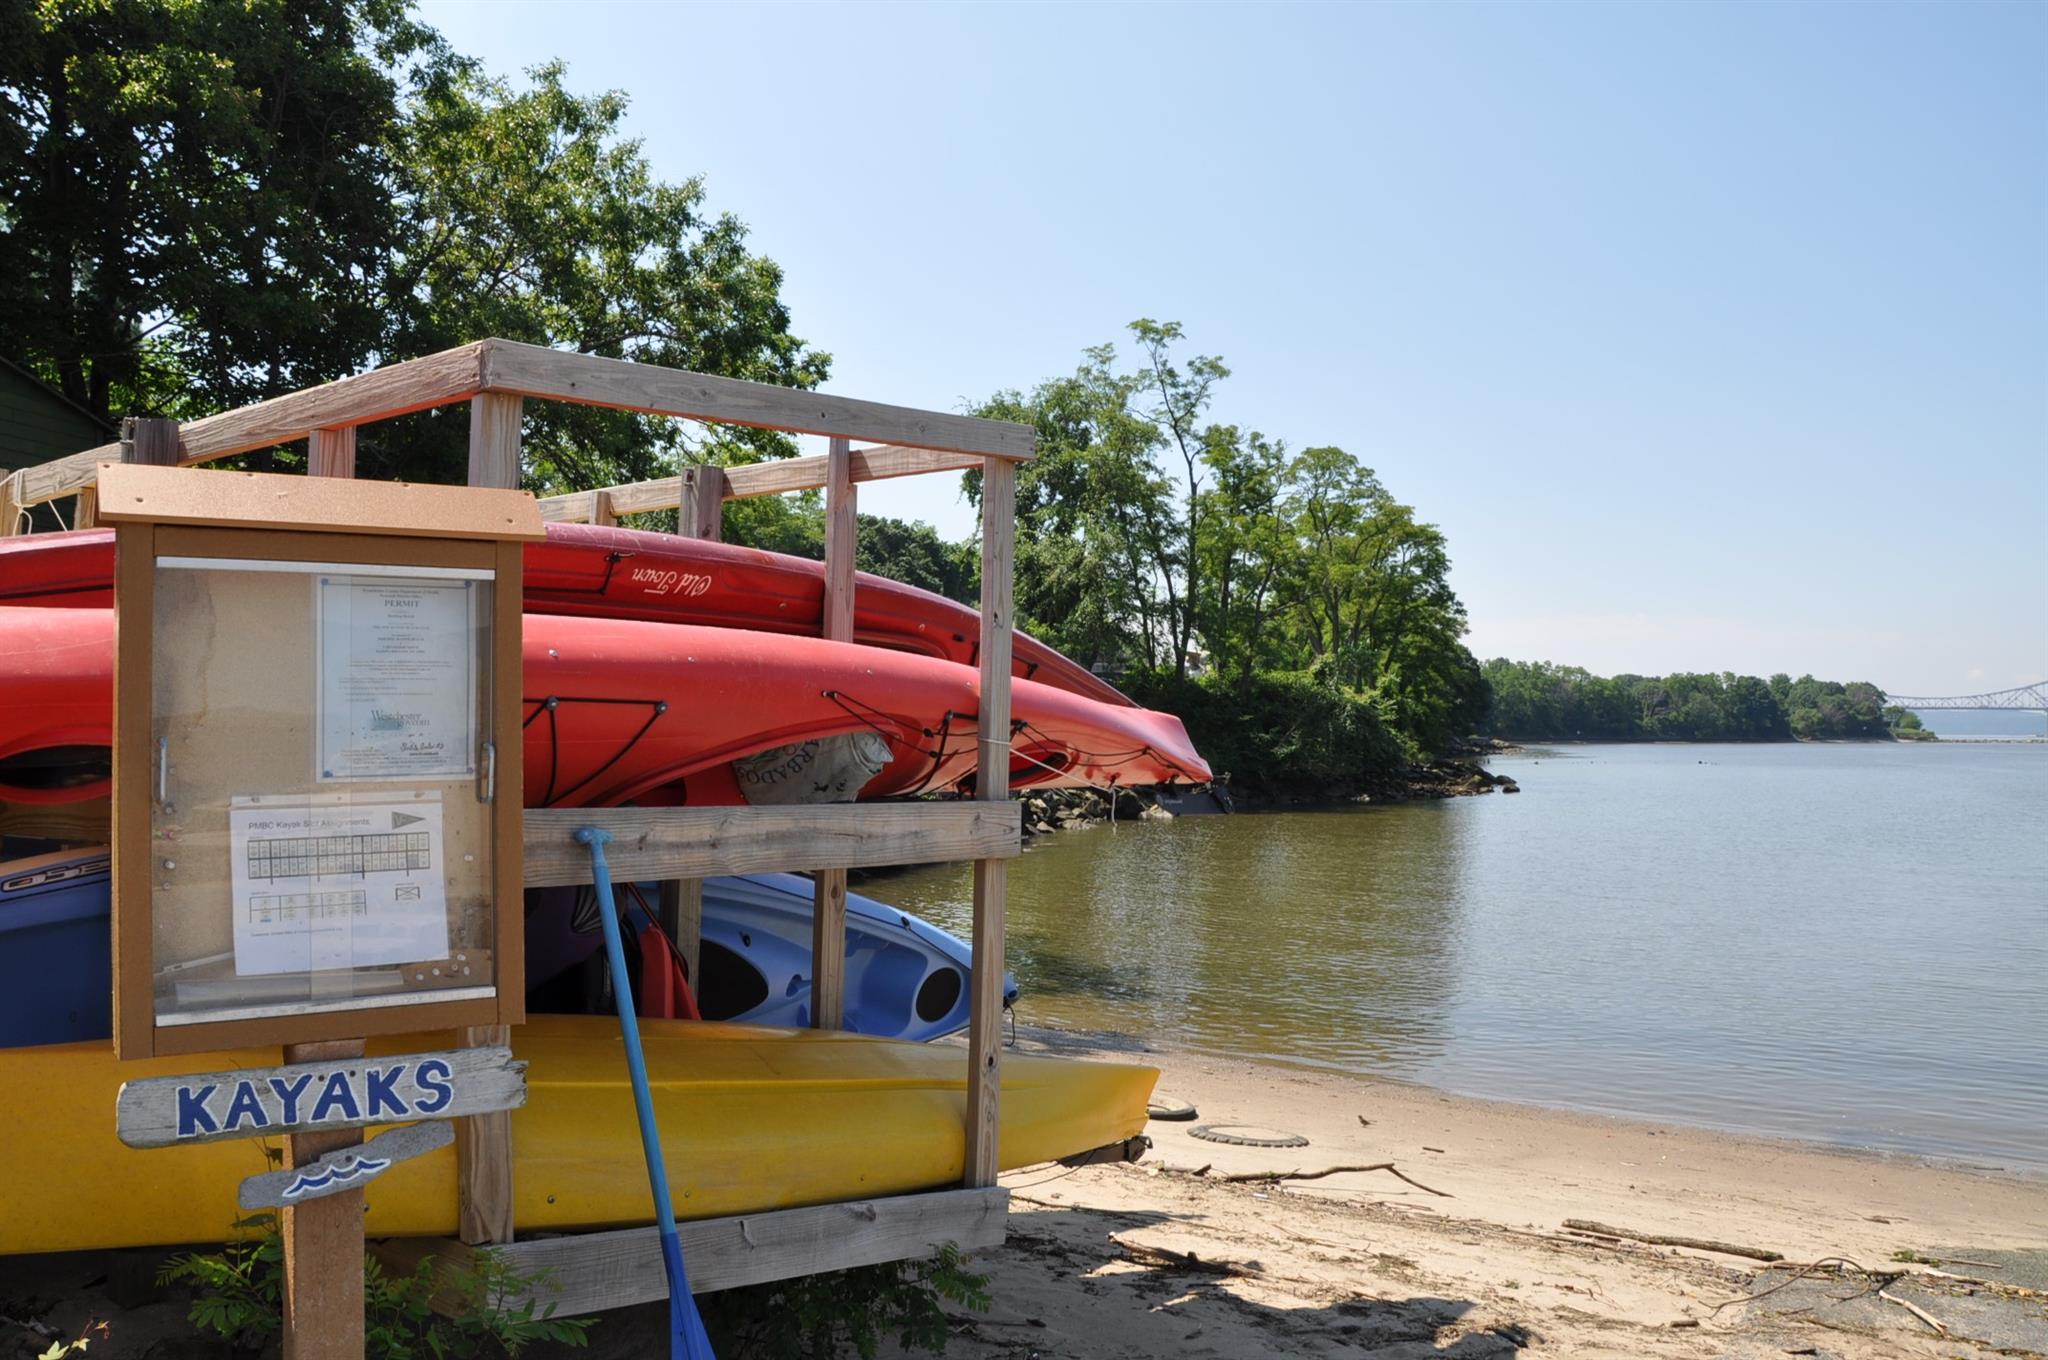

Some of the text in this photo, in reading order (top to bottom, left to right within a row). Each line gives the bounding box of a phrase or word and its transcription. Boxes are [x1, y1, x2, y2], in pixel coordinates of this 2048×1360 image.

[632, 568, 712, 597] Old Town
[384, 599, 420, 608] PERMIT
[736, 738, 820, 785] RBADOS
[248, 821, 274, 830] PMBC
[276, 820, 301, 830] Kayak
[176, 1058, 455, 1138] KAYAKS
